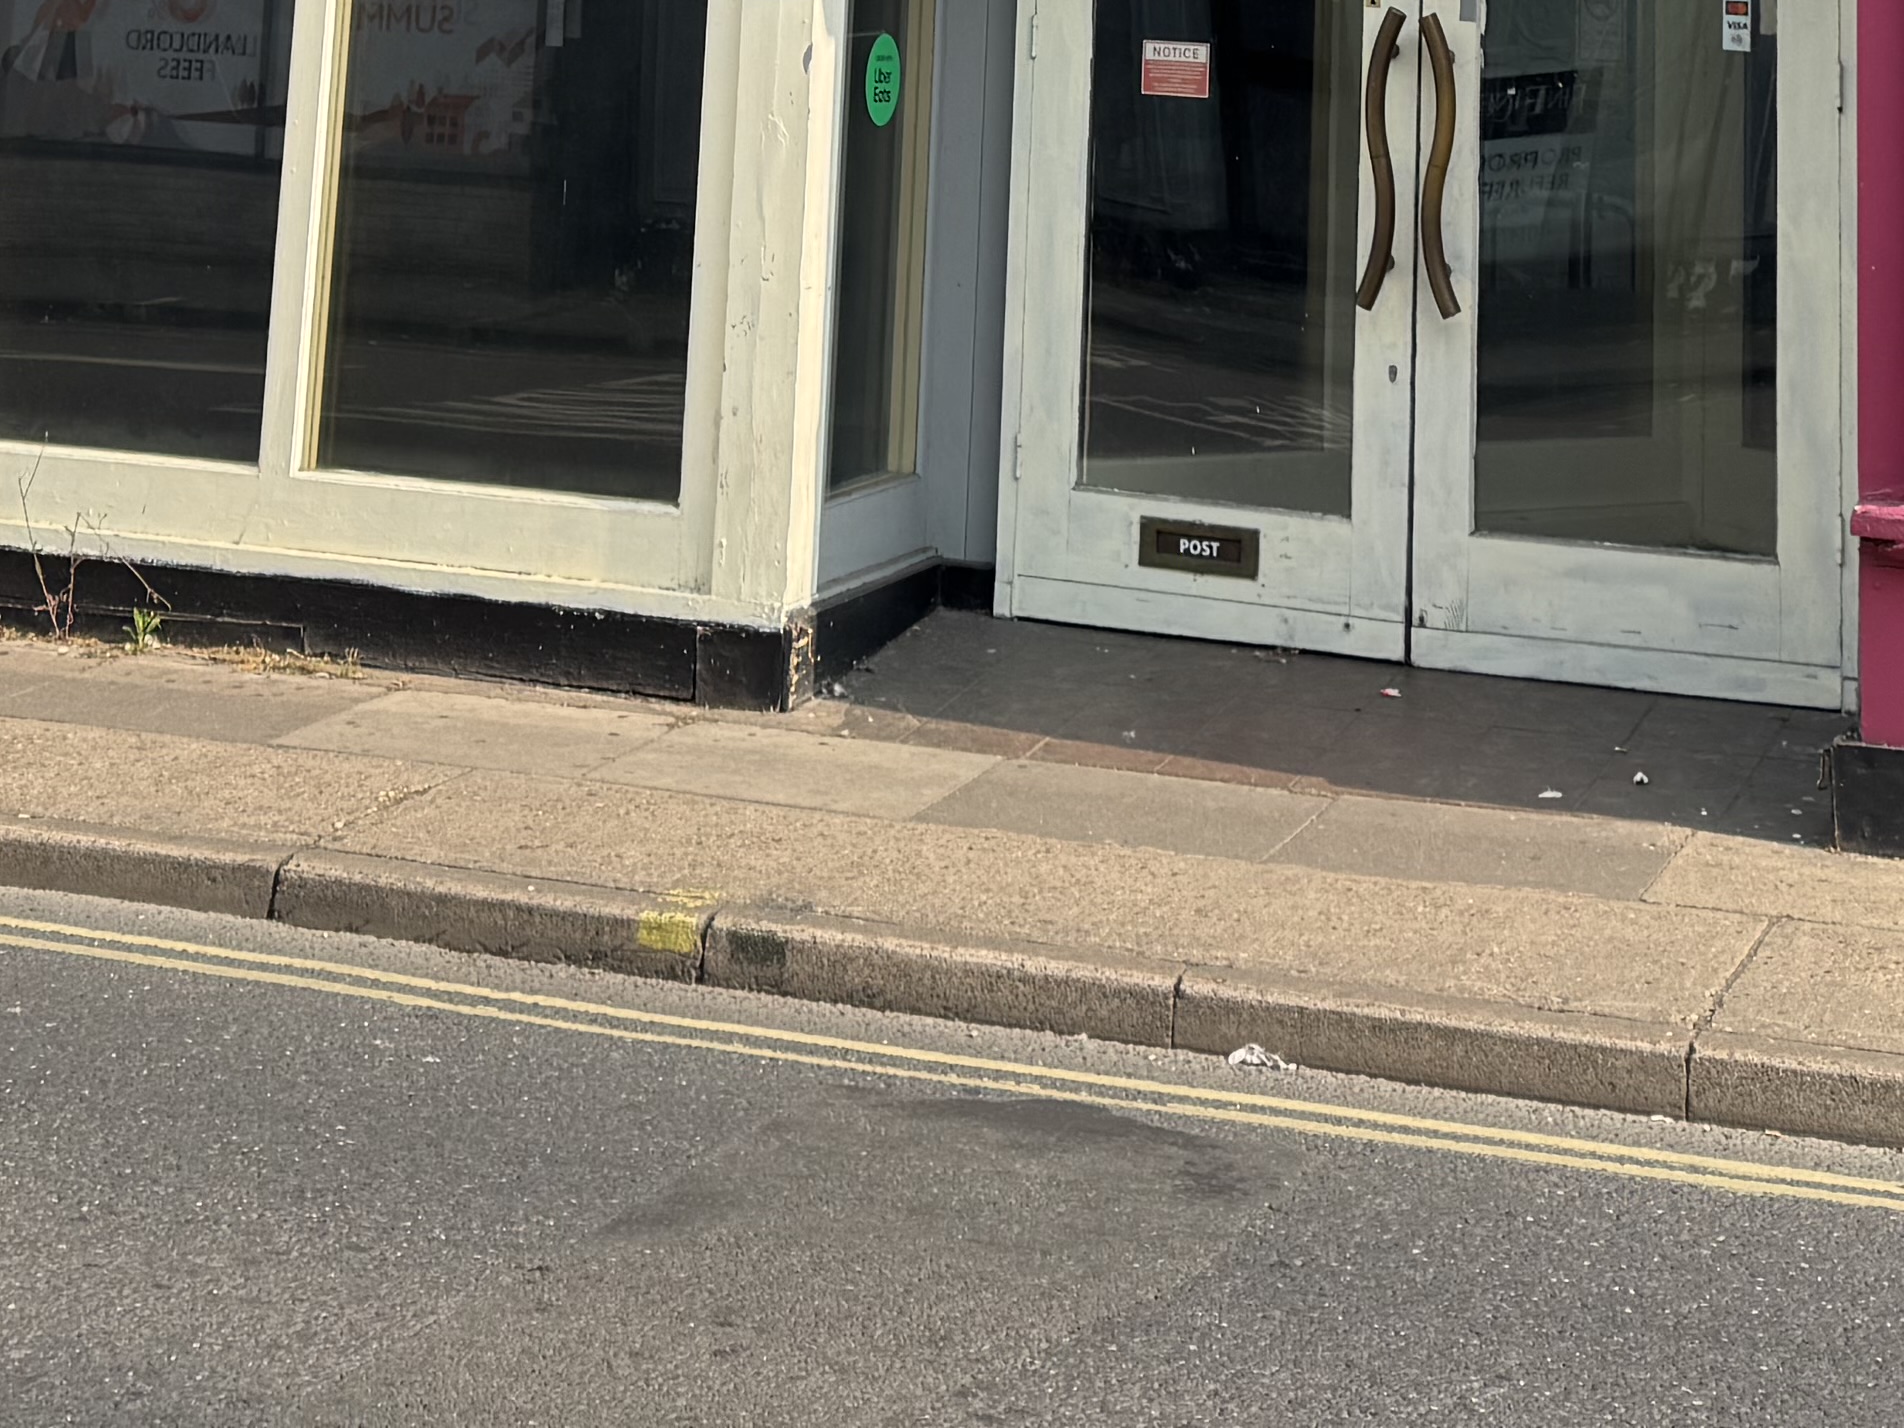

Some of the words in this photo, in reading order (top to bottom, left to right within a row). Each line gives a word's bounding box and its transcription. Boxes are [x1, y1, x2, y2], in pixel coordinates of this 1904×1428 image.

[1727, 21, 1748, 30] VISA
[1153, 46, 1199, 59] NOTICE
[874, 67, 892, 84] Uber
[873, 86, 891, 103] Eats
[1179, 538, 1220, 557] POST
